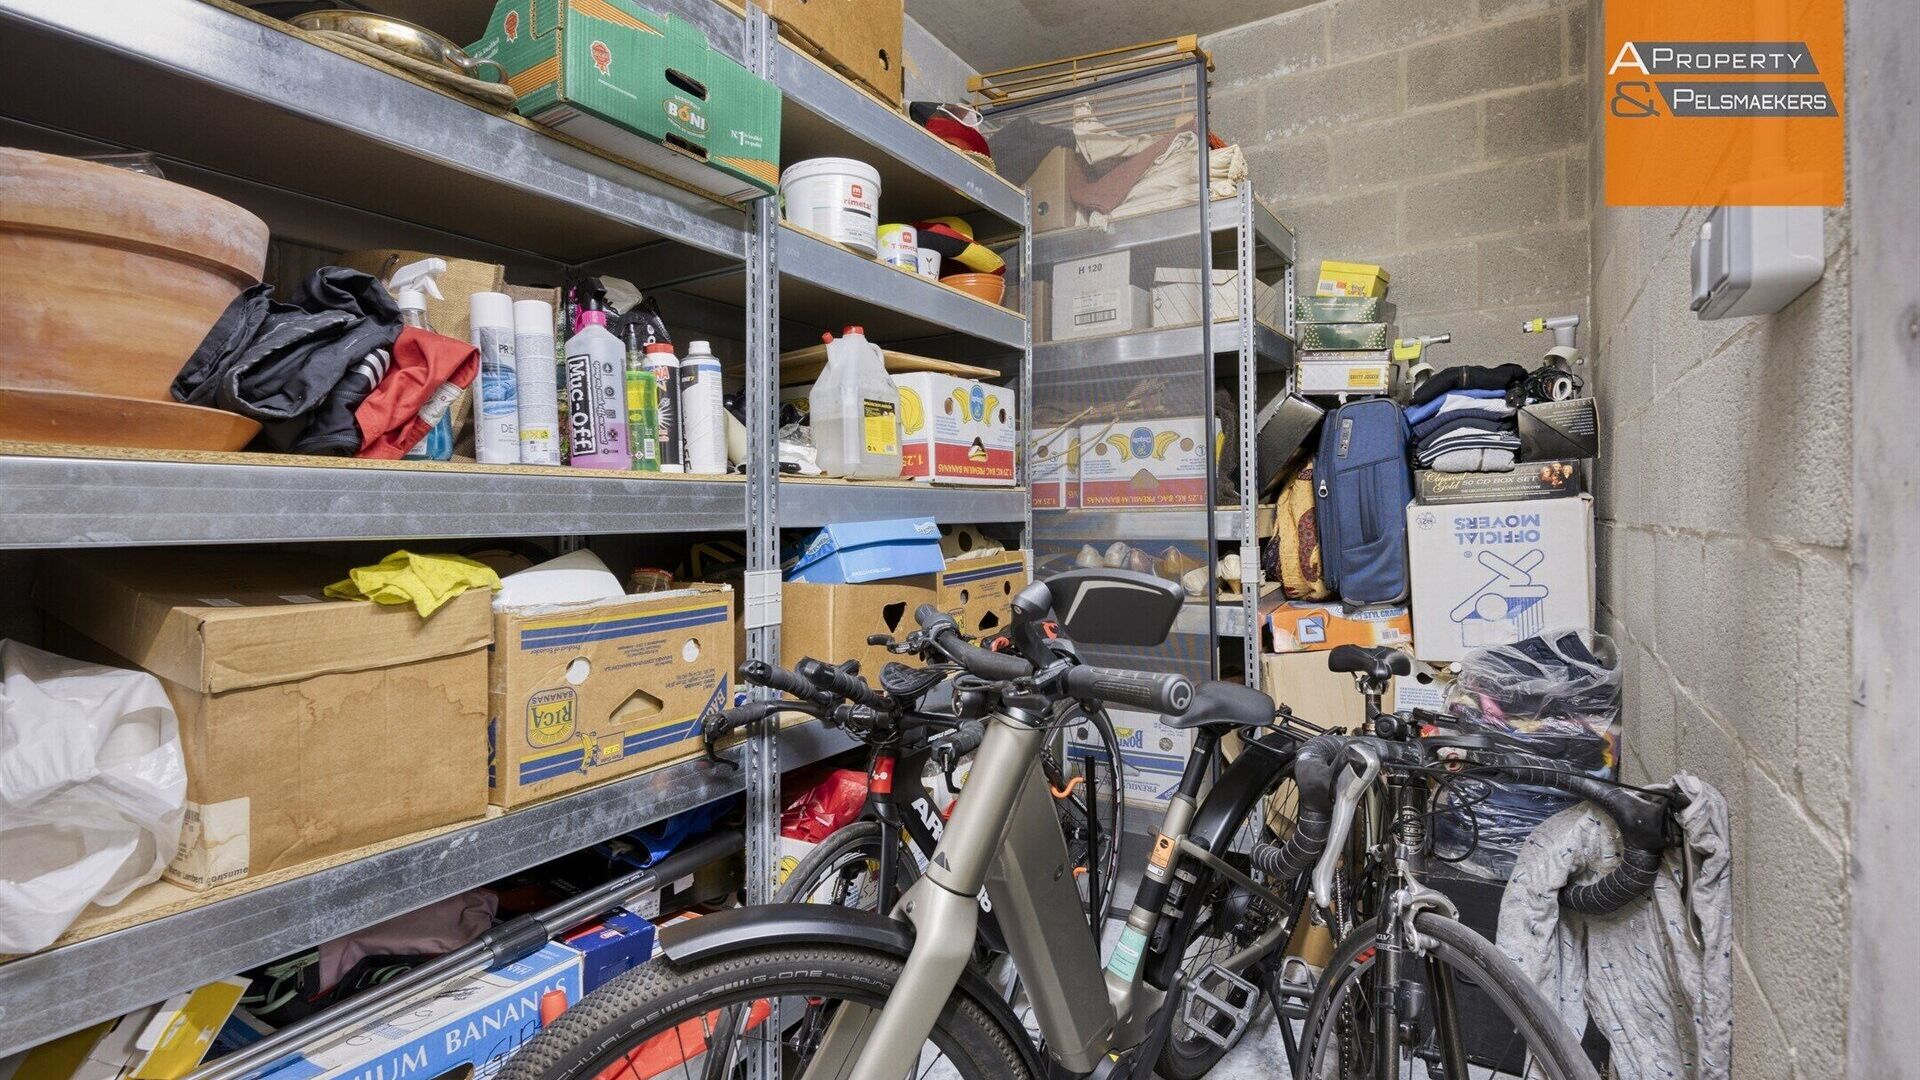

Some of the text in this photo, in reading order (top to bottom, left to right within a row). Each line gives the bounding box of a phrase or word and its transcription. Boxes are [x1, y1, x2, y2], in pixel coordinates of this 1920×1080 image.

[1078, 262, 1103, 274] H 120
[568, 360, 593, 452] Muc-Off
[1493, 476, 1514, 484] BOX
[1517, 475, 1540, 483] SET
[1454, 513, 1540, 530] MOVERS
[1454, 529, 1541, 545] OFFICIAL
[531, 690, 574, 706] BANANAS
[530, 700, 573, 729] RICA
[752, 970, 823, 985] G-ONE
